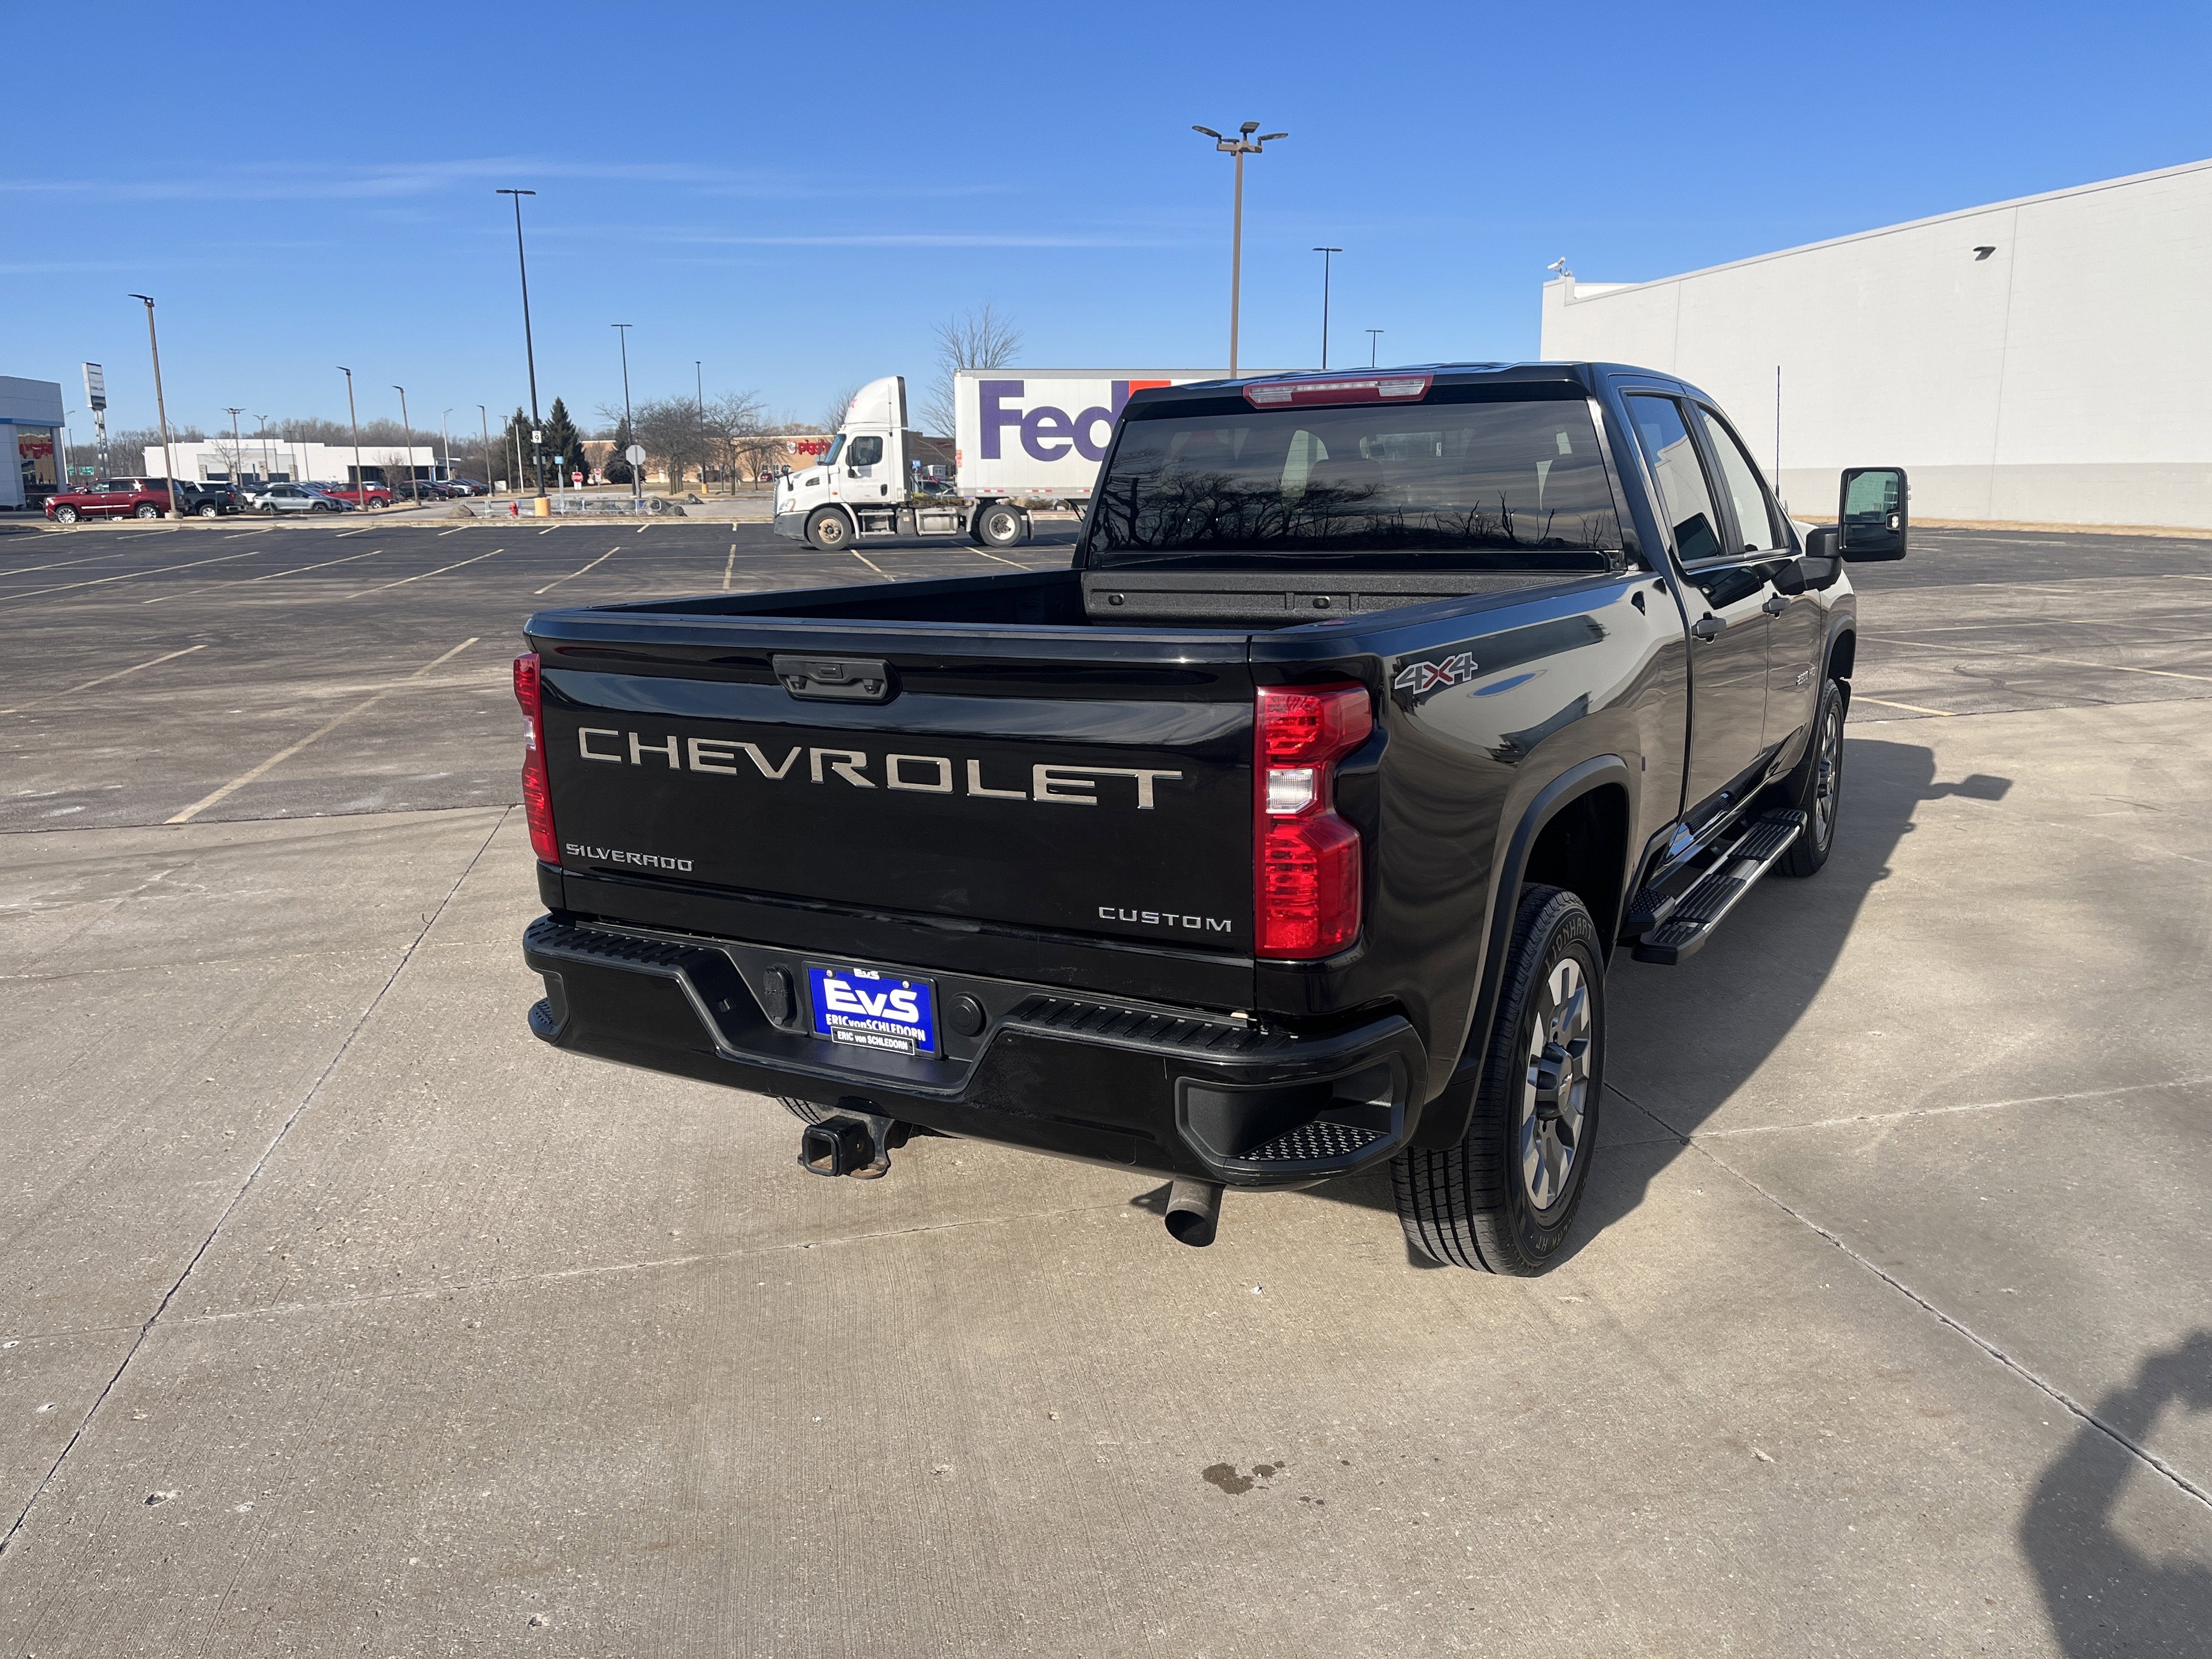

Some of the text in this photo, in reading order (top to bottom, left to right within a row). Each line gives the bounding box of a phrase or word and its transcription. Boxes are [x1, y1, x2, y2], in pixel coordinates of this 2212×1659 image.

[979, 380, 1171, 461] Fed
[578, 727, 1183, 809] CHEVROLET
[566, 843, 694, 872] SILVERADO
[1098, 906, 1232, 933] CUSTOM
[1545, 917, 1592, 974] LIONHART
[837, 1031, 908, 1051] ERIC von SCHLEDORN
